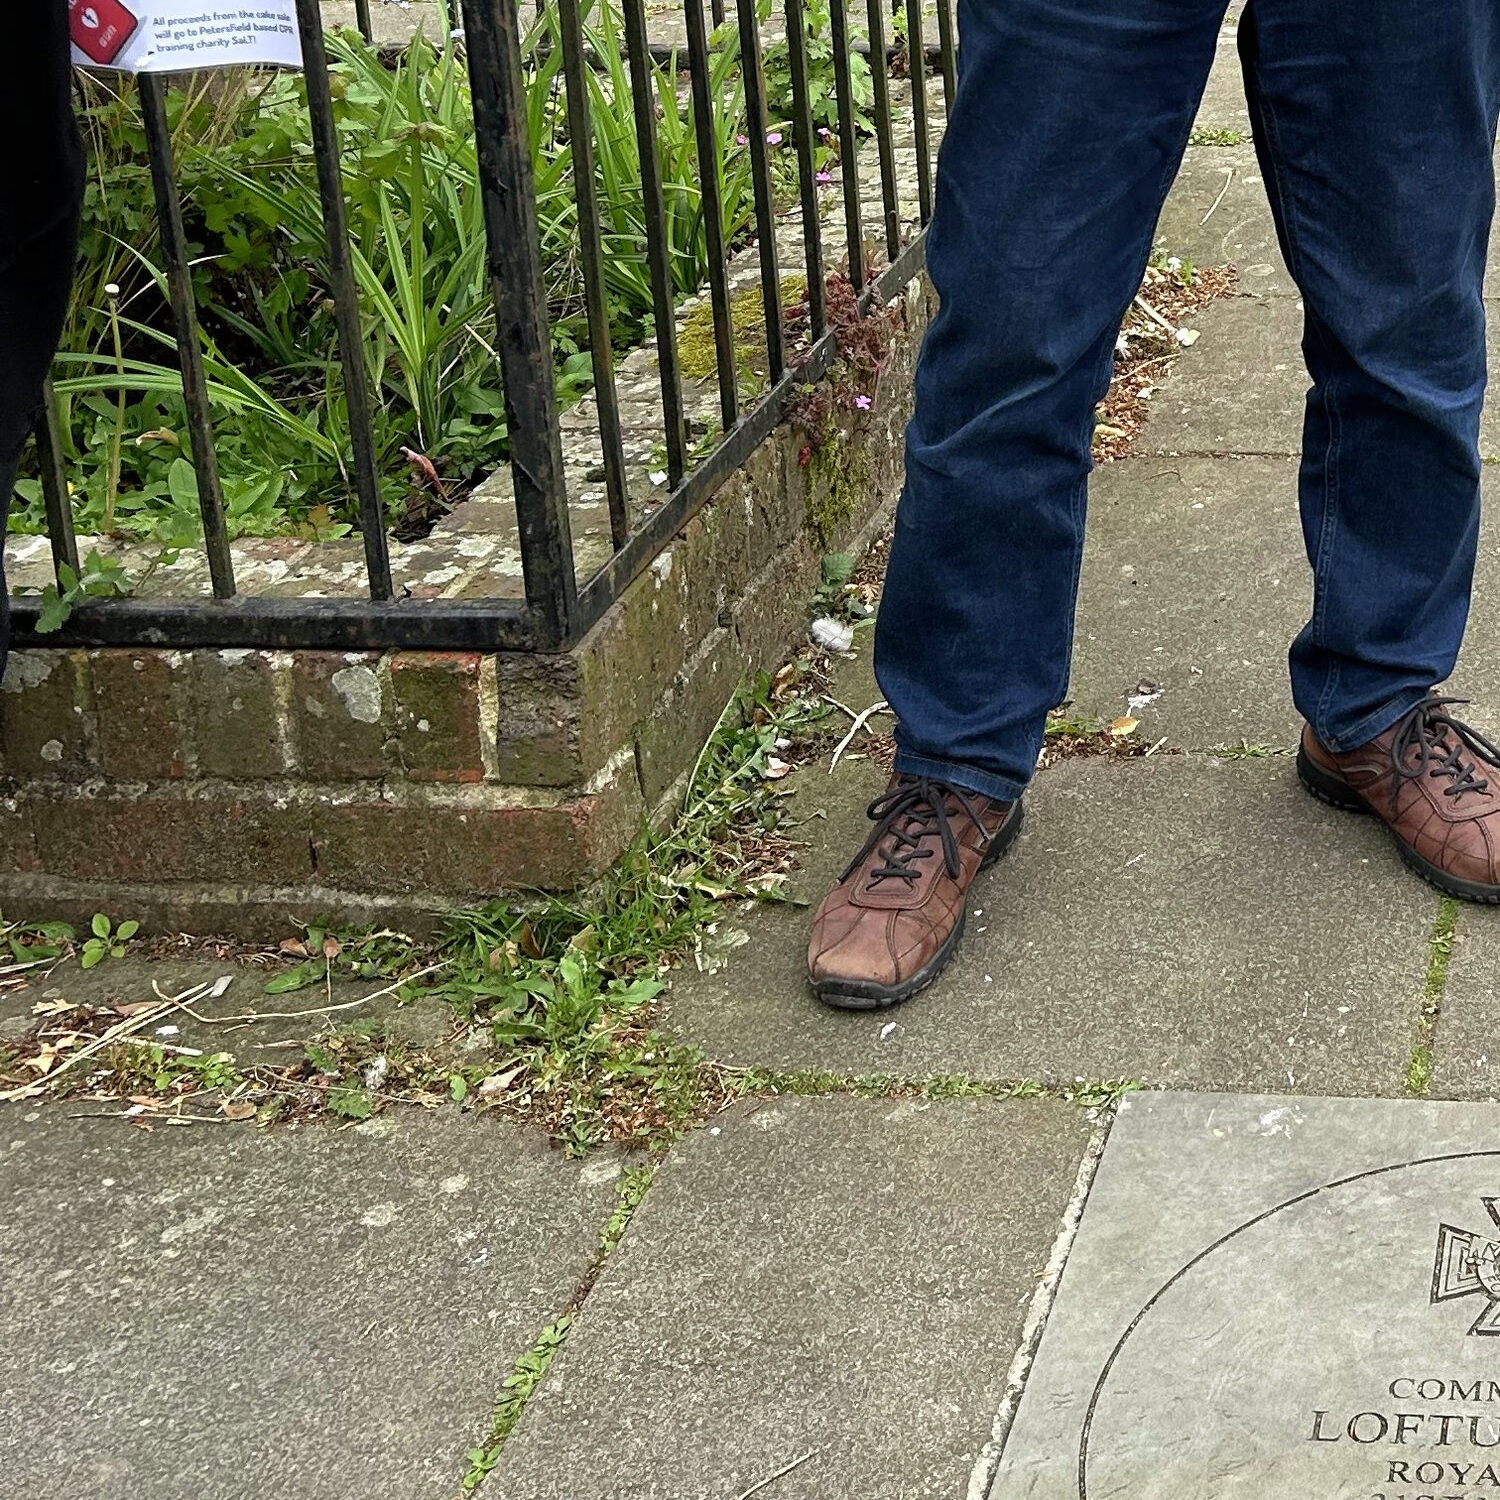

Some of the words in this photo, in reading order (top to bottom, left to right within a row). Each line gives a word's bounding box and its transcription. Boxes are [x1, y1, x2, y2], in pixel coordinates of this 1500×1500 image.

[152, 16, 166, 27] All
[167, 13, 212, 28] proceeds
[213, 11, 238, 22] from
[238, 10, 254, 20] the
[255, 10, 276, 21] cake
[154, 29, 172, 40] will
[173, 30, 186, 41] go
[187, 28, 198, 38] to
[199, 22, 251, 37] Petersfield
[252, 23, 278, 34] based
[156, 40, 196, 53] training
[196, 38, 230, 51] charity
